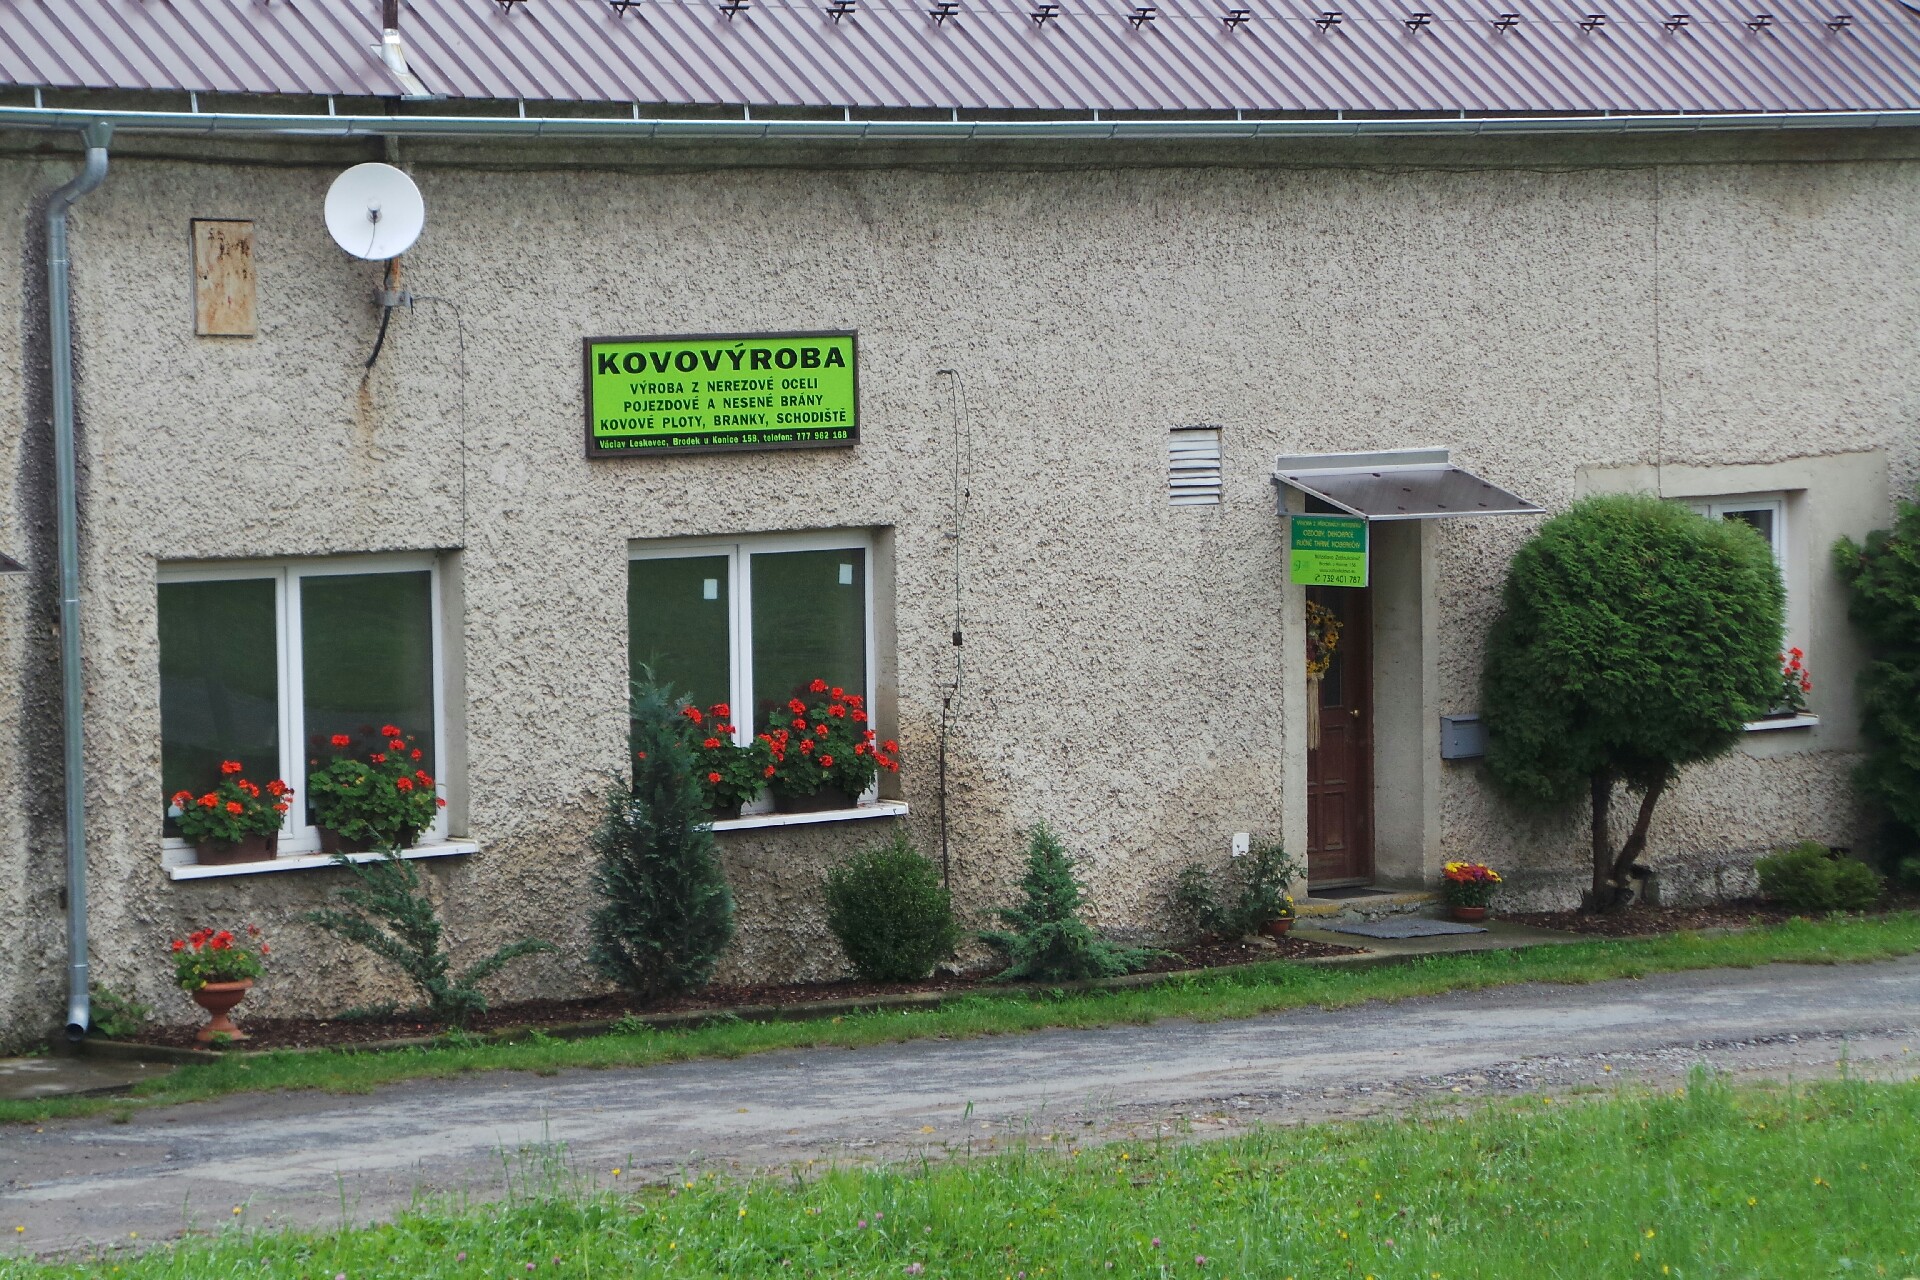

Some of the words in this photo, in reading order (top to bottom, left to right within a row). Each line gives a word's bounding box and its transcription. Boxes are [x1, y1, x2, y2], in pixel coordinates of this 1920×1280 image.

[598, 343, 846, 375] KOVOVÝROBA
[629, 380, 684, 395] VÝROBA
[691, 381, 700, 393] Z
[707, 376, 774, 392] NEREZOVÉ
[781, 377, 818, 390] OCELI
[623, 396, 700, 412] POJEZDOVÉ
[707, 398, 716, 410] A
[723, 393, 774, 409] NESENÉ
[780, 392, 823, 407] BRÁNY
[600, 415, 655, 430] KOVOVÉ
[662, 415, 706, 430] PLOTY,
[713, 413, 769, 428] BRANKY,
[776, 408, 847, 424] SCHODIŠTĚ
[599, 440, 626, 450] Václav
[672, 436, 700, 446] Brodek
[712, 434, 739, 445] Konice
[763, 432, 793, 442] telefon:
[796, 431, 811, 441] 777
[1322, 574, 1335, 583] 732
[1349, 575, 1361, 584] 787
